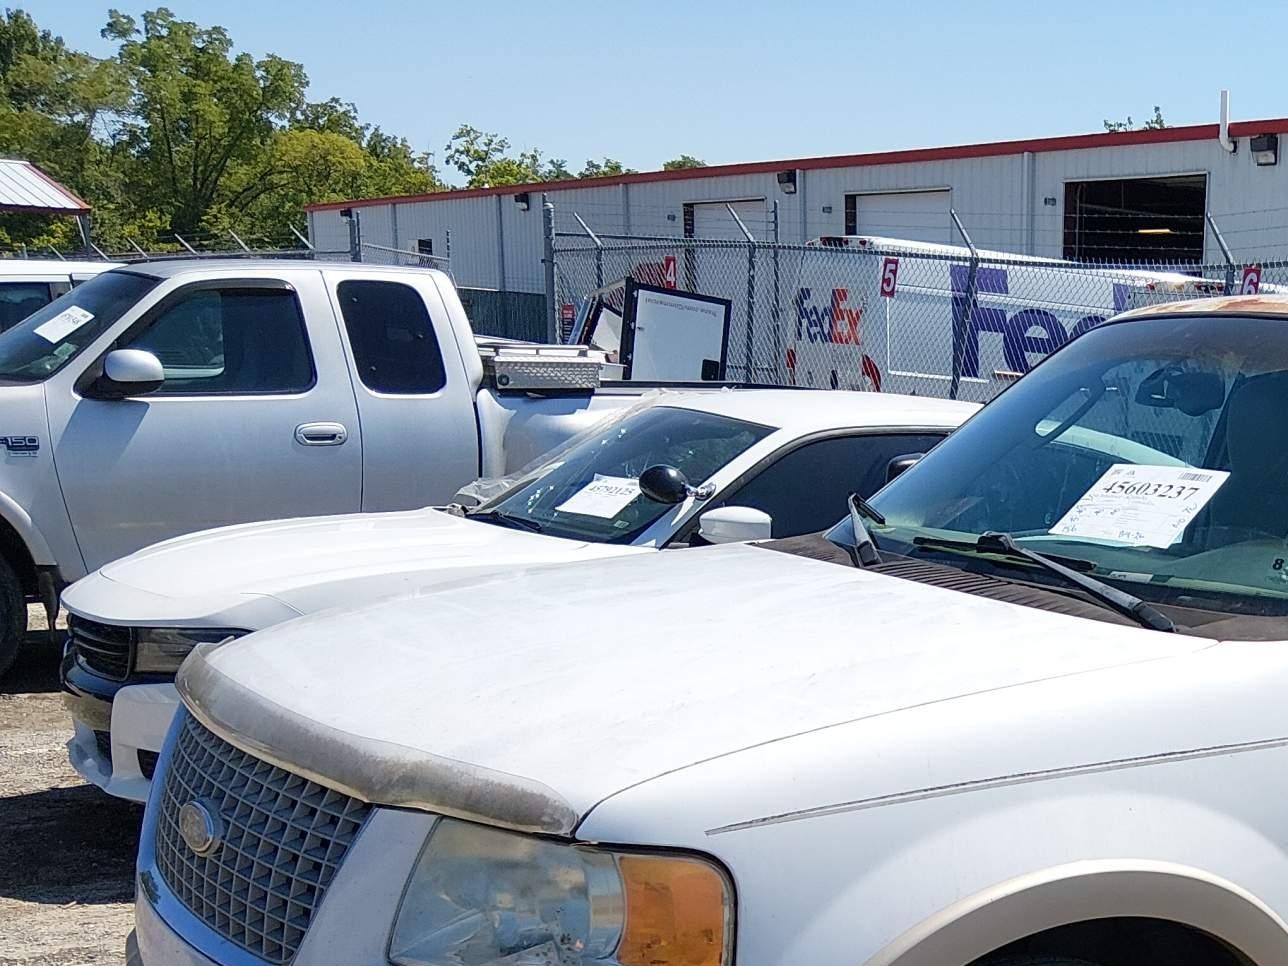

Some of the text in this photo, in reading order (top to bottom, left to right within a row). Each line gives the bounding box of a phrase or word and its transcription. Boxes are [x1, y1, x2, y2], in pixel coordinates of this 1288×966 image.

[666, 260, 676, 287] 4
[883, 263, 895, 292] 5
[796, 287, 863, 345] FedEx
[1102, 480, 1200, 501] 45603237
[1272, 558, 1285, 571] 8
